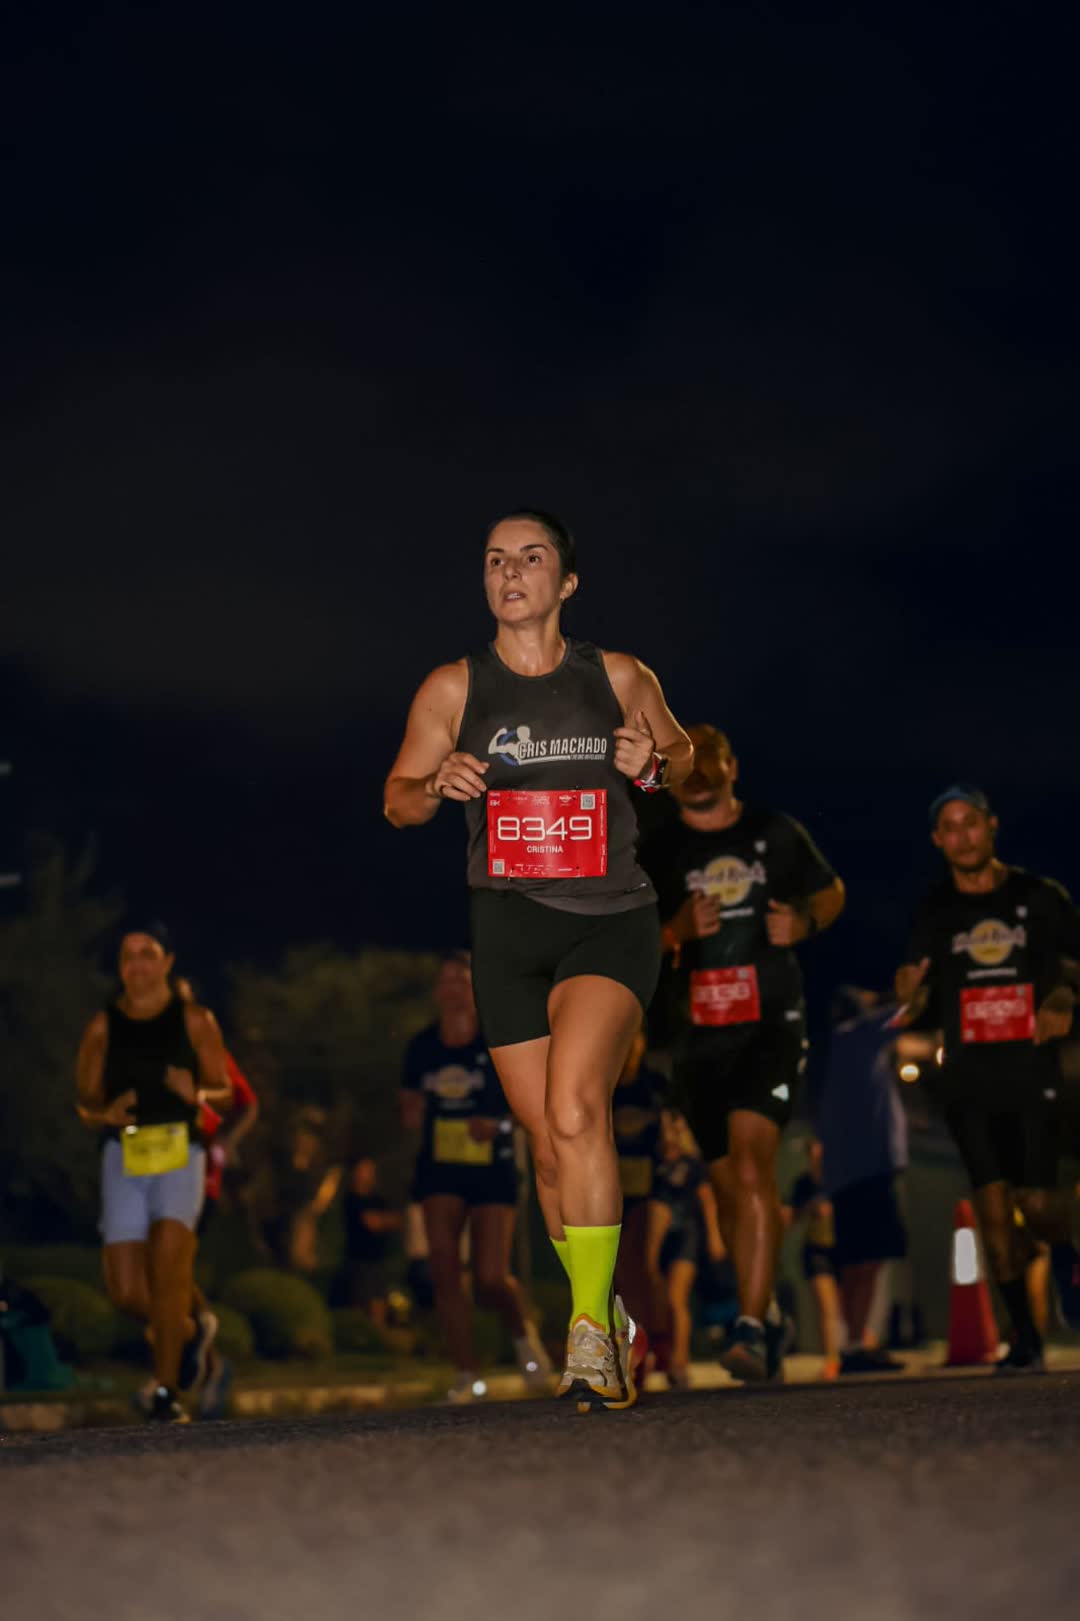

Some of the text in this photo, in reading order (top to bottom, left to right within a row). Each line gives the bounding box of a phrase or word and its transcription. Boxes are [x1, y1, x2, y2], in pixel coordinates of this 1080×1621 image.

[519, 737, 607, 759] CRIS MACHADO
[497, 816, 592, 841] 8349
[526, 845, 564, 853] CRISTINA
